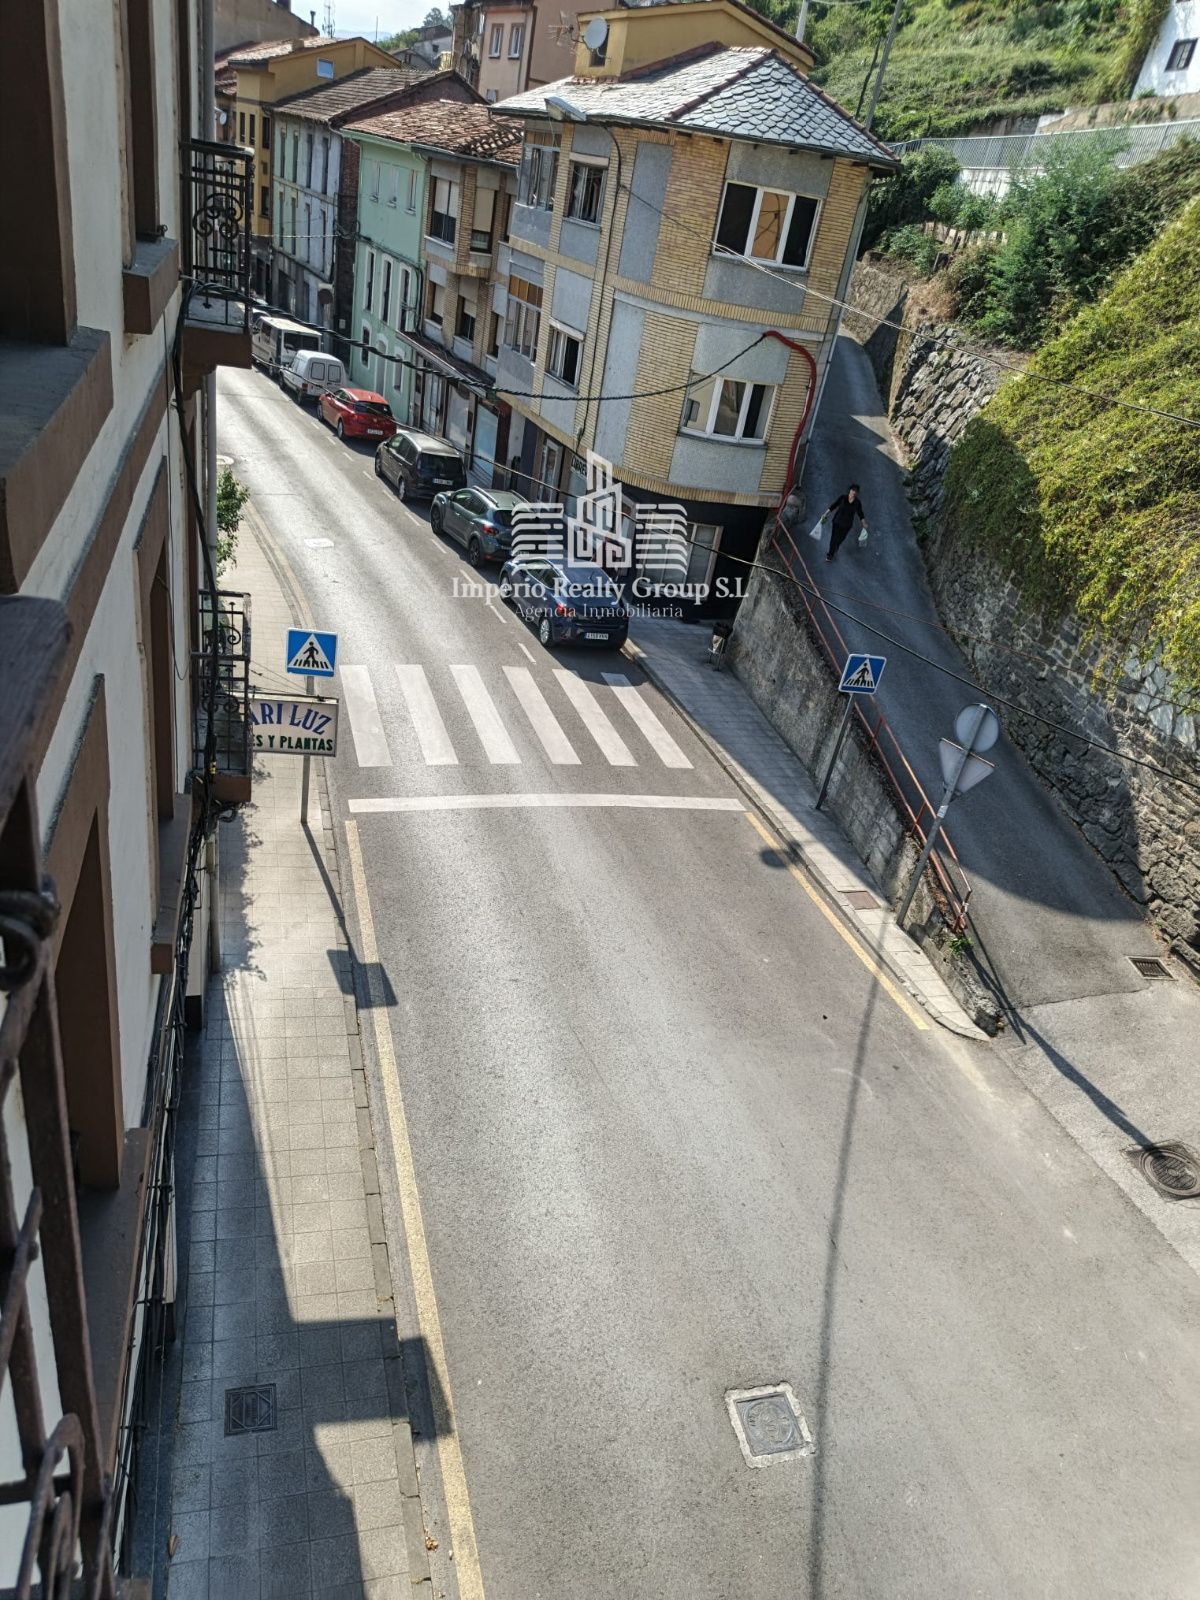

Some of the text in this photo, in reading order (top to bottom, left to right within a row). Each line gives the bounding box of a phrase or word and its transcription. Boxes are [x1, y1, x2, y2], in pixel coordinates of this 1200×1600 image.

[289, 704, 332, 735] LUZ
[253, 734, 333, 751] S Y PLANTAS
